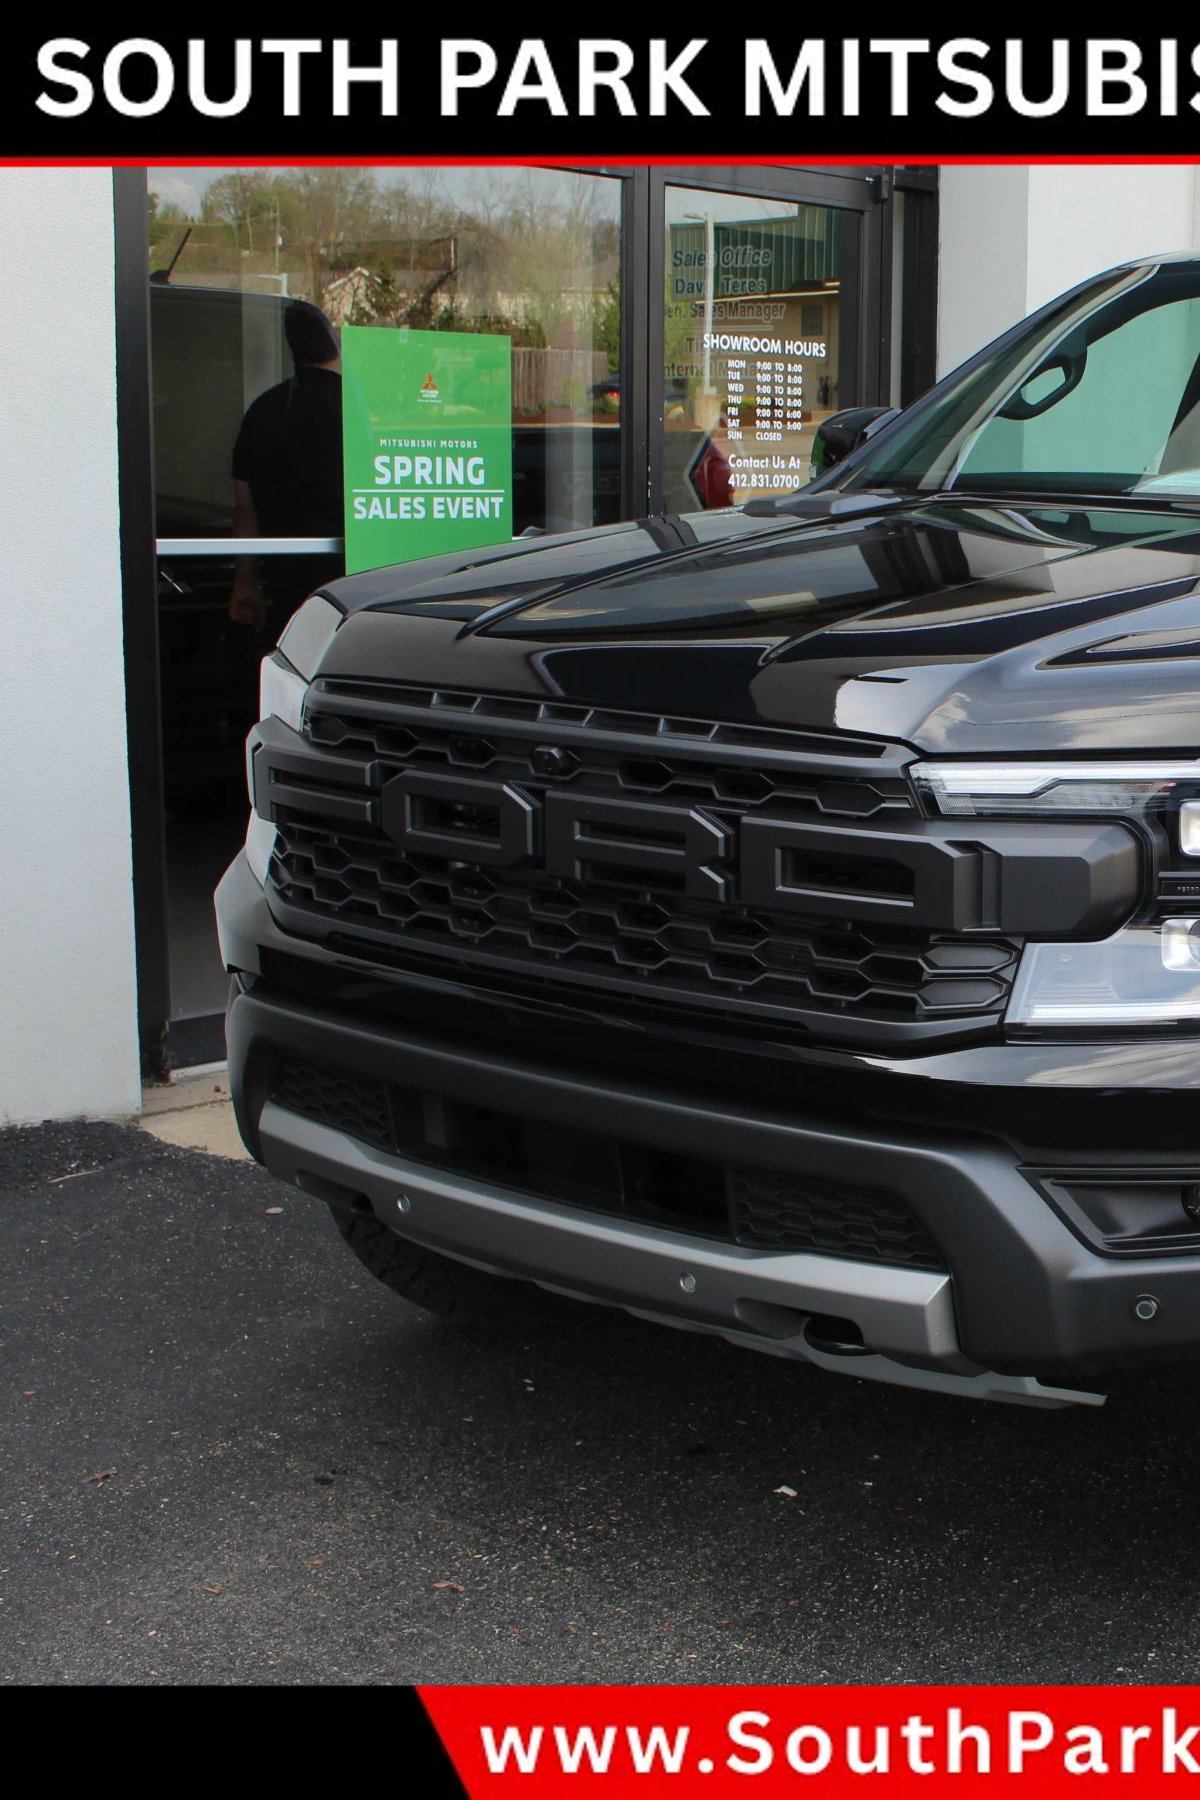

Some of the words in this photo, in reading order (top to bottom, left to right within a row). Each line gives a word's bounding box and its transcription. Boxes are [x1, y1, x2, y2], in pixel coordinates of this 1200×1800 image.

[727, 301, 785, 322] Manager
[703, 333, 782, 355] SHOWROOM
[785, 340, 826, 358] HOURS
[727, 359, 746, 369] MON
[756, 361, 772, 371] 9:00
[774, 362, 785, 372] TO
[787, 363, 803, 373] 8:00
[727, 371, 741, 381] TUE
[756, 372, 772, 383] 9:00
[774, 374, 784, 384] TO
[787, 375, 803, 385] 8:00
[727, 383, 744, 393] WED
[756, 384, 772, 394] 9:00
[774, 385, 784, 395] TO
[786, 386, 802, 396] 8:00
[727, 395, 742, 404] THU
[756, 396, 772, 406] 9:00
[774, 397, 784, 407] TO
[727, 407, 739, 416] FRI
[756, 408, 771, 418] 9:00
[774, 409, 784, 418] TO
[786, 410, 802, 419] 6:00
[727, 419, 740, 428] SAT
[755, 420, 771, 429] 9:00
[773, 421, 783, 430] TO
[786, 421, 802, 431] 5:00
[727, 430, 743, 440] SUN
[755, 431, 782, 442] CLOSED
[379, 438, 436, 448] MITSUBISHI
[440, 440, 478, 449] MOTORS
[728, 454, 770, 469] Contact
[772, 455, 786, 469] Us
[788, 455, 800, 469] At
[374, 455, 485, 485] SPRING
[728, 473, 800, 489] 412.831.0700
[353, 496, 426, 520] SALES
[432, 496, 504, 519] EVENT
[254, 738, 968, 932] FORD
